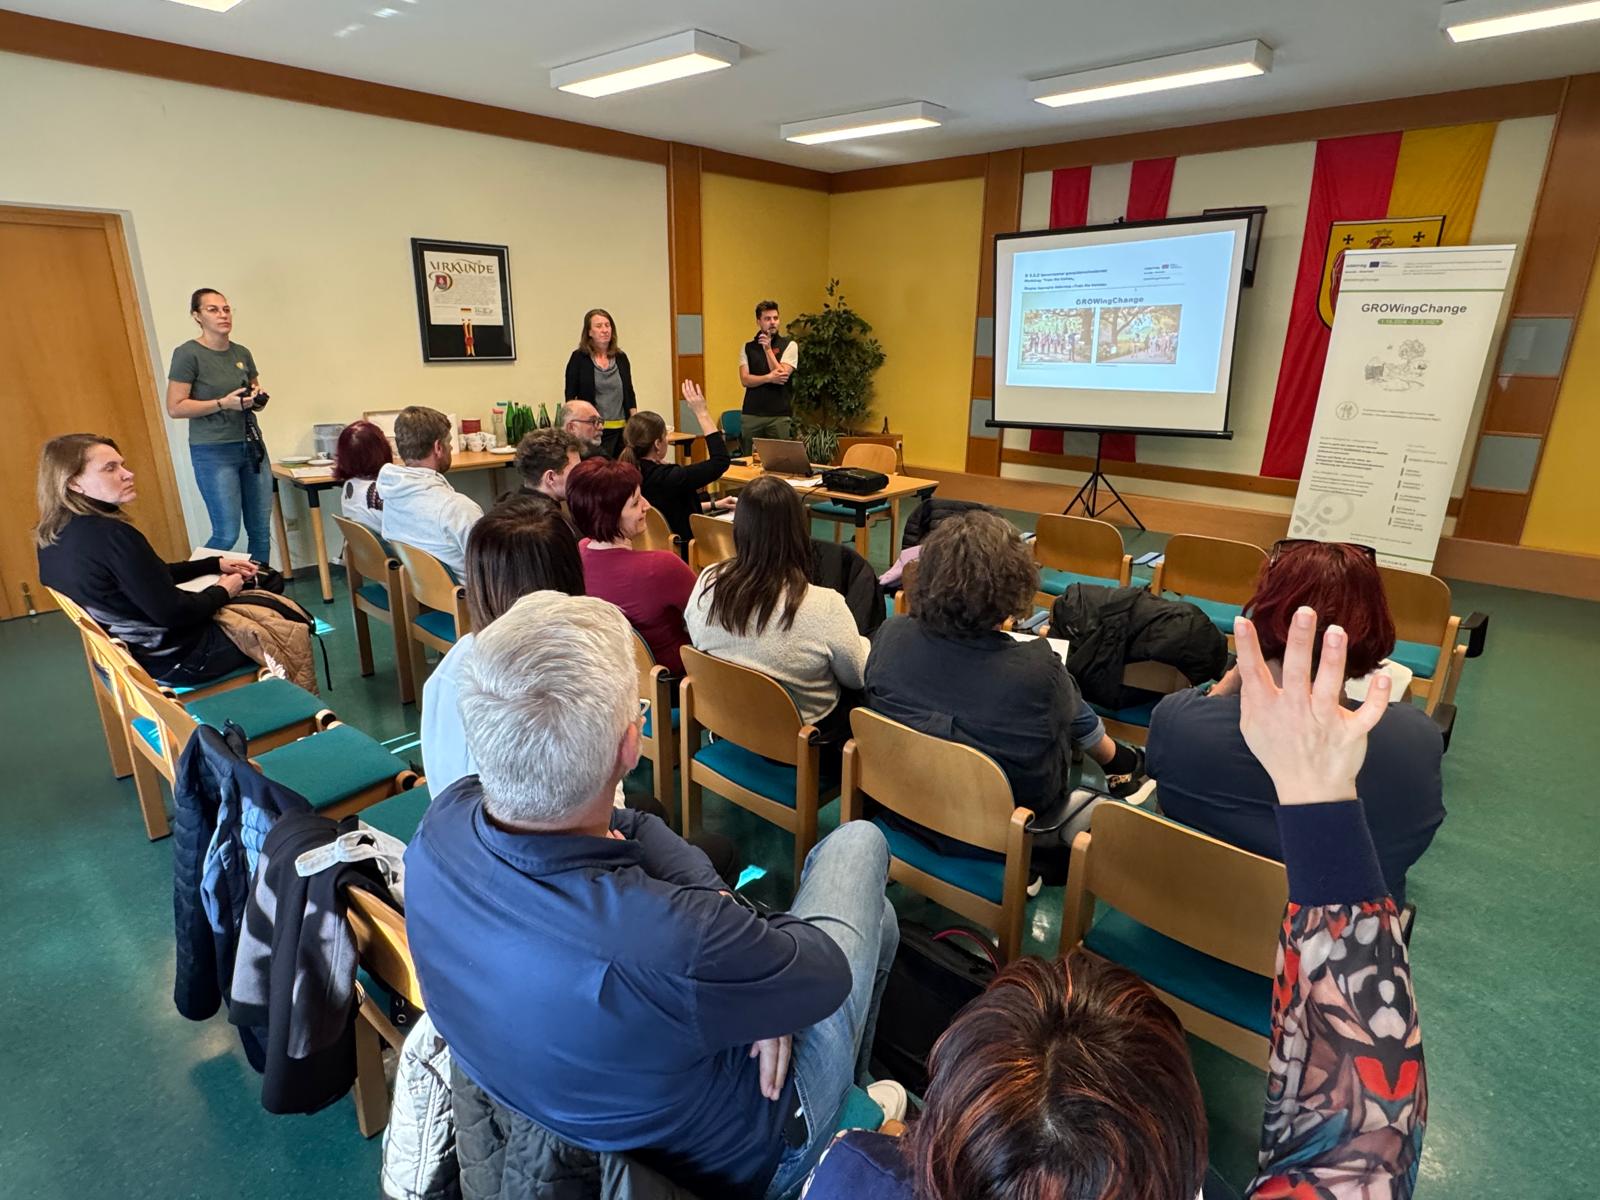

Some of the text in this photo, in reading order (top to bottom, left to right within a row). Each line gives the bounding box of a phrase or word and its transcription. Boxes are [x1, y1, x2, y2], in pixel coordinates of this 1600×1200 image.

[430, 261, 495, 274] URKUNDE
[1075, 296, 1144, 305] GROWingChange
[1361, 303, 1467, 315] GROWingChange
